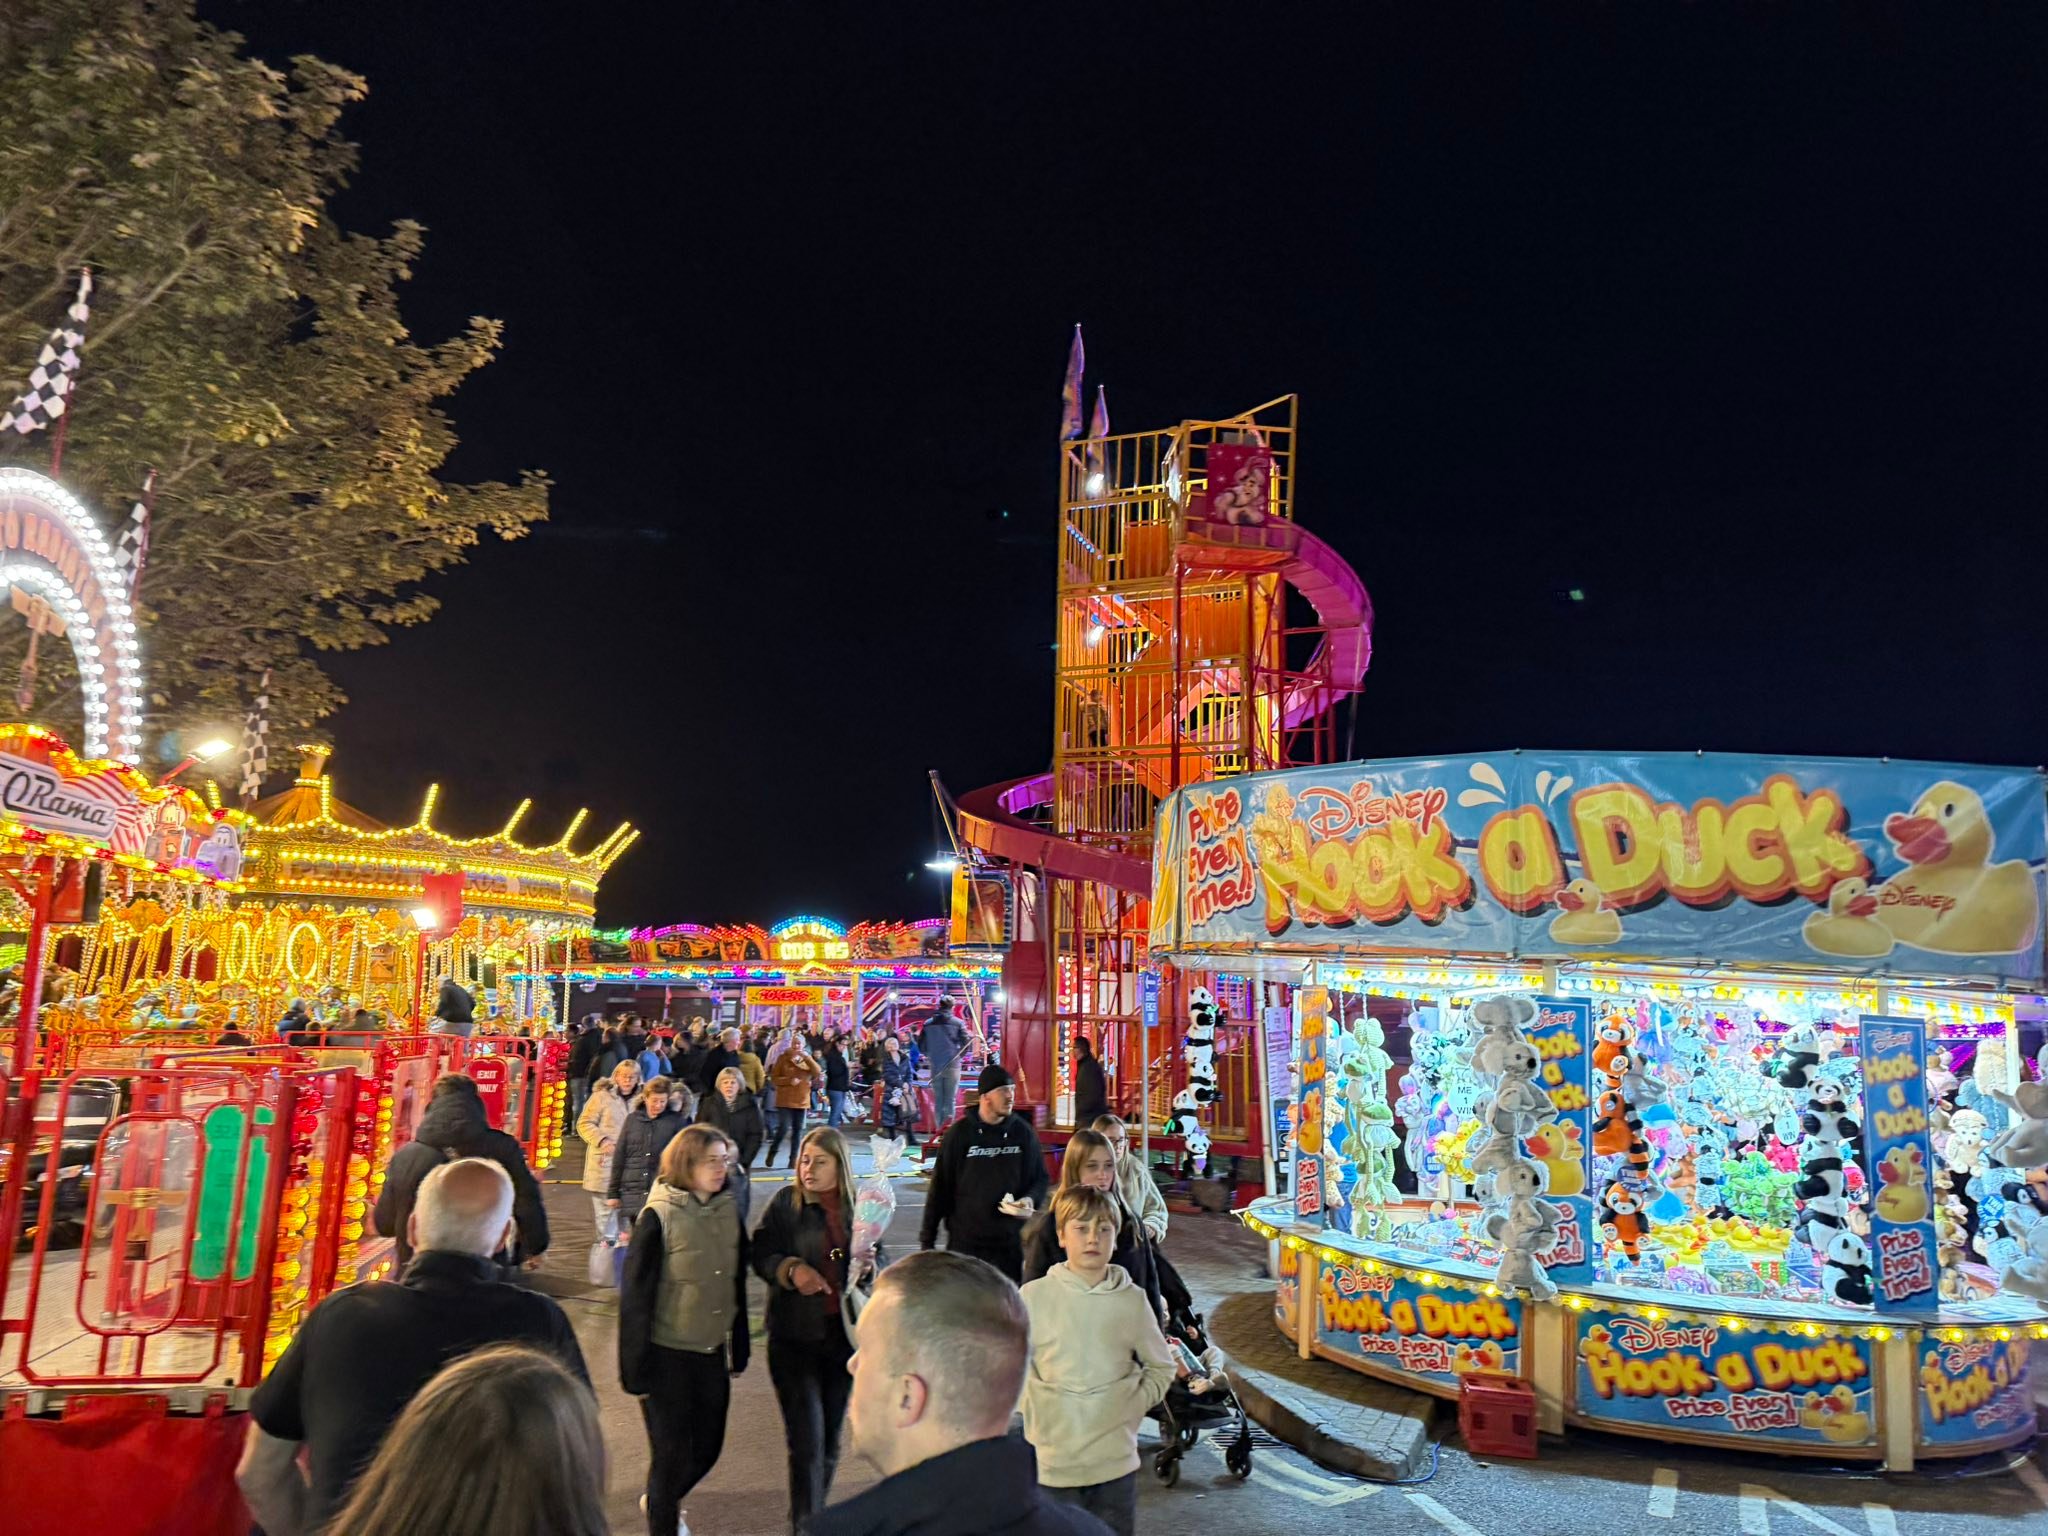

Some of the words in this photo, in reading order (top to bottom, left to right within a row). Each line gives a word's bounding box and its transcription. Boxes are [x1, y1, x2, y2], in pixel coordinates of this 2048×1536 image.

[1188, 788, 1241, 843] Prize
[1301, 780, 1447, 839] Disney
[1188, 826, 1248, 882] Every
[1264, 816, 1471, 933] Hook
[1478, 804, 1566, 912] a
[1570, 773, 1867, 909] Duck
[1880, 882, 1956, 921] Disney
[759, 989, 809, 1000] TOKENS
[1525, 1031, 1583, 1062] ook
[476, 1070, 498, 1079] EXIT
[1542, 1062, 1564, 1086] a
[1863, 1052, 1919, 1085] Hook
[1457, 1086, 1472, 1094] ME
[1547, 1083, 1591, 1111] uck
[1888, 1084, 1906, 1108] a
[1874, 1105, 1928, 1139] Duck
[966, 1145, 1020, 1157] Snap-on
[1878, 1229, 1923, 1254] Prize
[1882, 1248, 1927, 1277] Every
[1334, 1264, 1394, 1302] Disney
[1323, 1293, 1391, 1333] Hook
[1391, 1299, 1418, 1335] a
[1417, 1294, 1517, 1339] Duck
[1360, 1335, 1397, 1354] Prize
[1399, 1336, 1448, 1357] Every
[1610, 1319, 1718, 1356] Disney
[1588, 1351, 1714, 1397] Hook
[1715, 1353, 1754, 1392] a
[1752, 1340, 1867, 1390] Duck
[1667, 1399, 1727, 1418] Prize
[1730, 1394, 1796, 1414] Every
[1925, 1365, 1994, 1423] Hook
